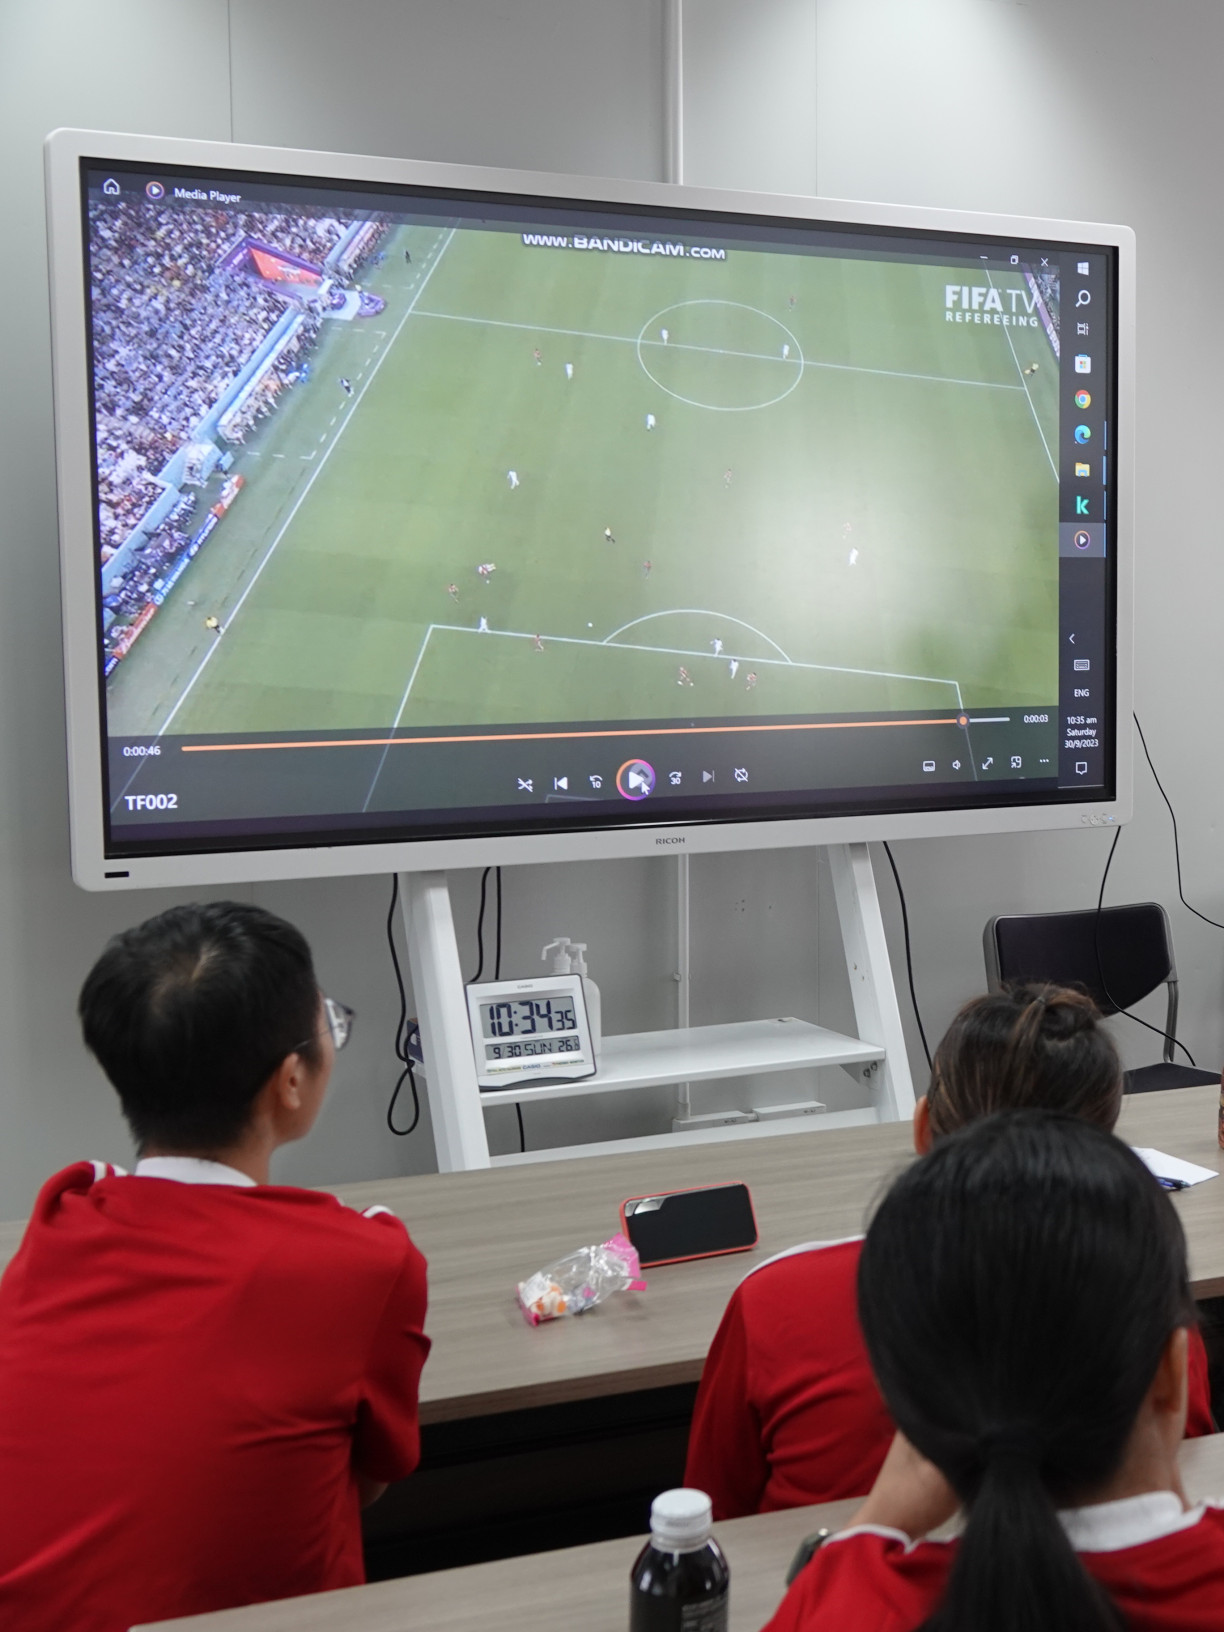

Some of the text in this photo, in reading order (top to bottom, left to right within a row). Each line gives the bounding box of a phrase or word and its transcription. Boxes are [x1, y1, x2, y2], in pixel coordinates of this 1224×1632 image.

[174, 187, 242, 205] Media Player
[945, 284, 1003, 312] FIFA
[1006, 288, 1037, 314] TV
[945, 310, 1039, 328] REFEREEING
[1074, 689, 1090, 697] ENG
[1023, 714, 1049, 723] 0:00:03
[1066, 715, 1085, 725] 10:35
[1066, 728, 1097, 737] Saturday
[1064, 738, 1099, 749] 30/9/2023
[123, 745, 161, 757] 0:00:46
[124, 793, 178, 811] TF002
[655, 837, 686, 845] RICOH
[489, 1000, 577, 1037] 10:34 35
[524, 1042, 552, 1057] SUN
[522, 1063, 541, 1071] CASIO
